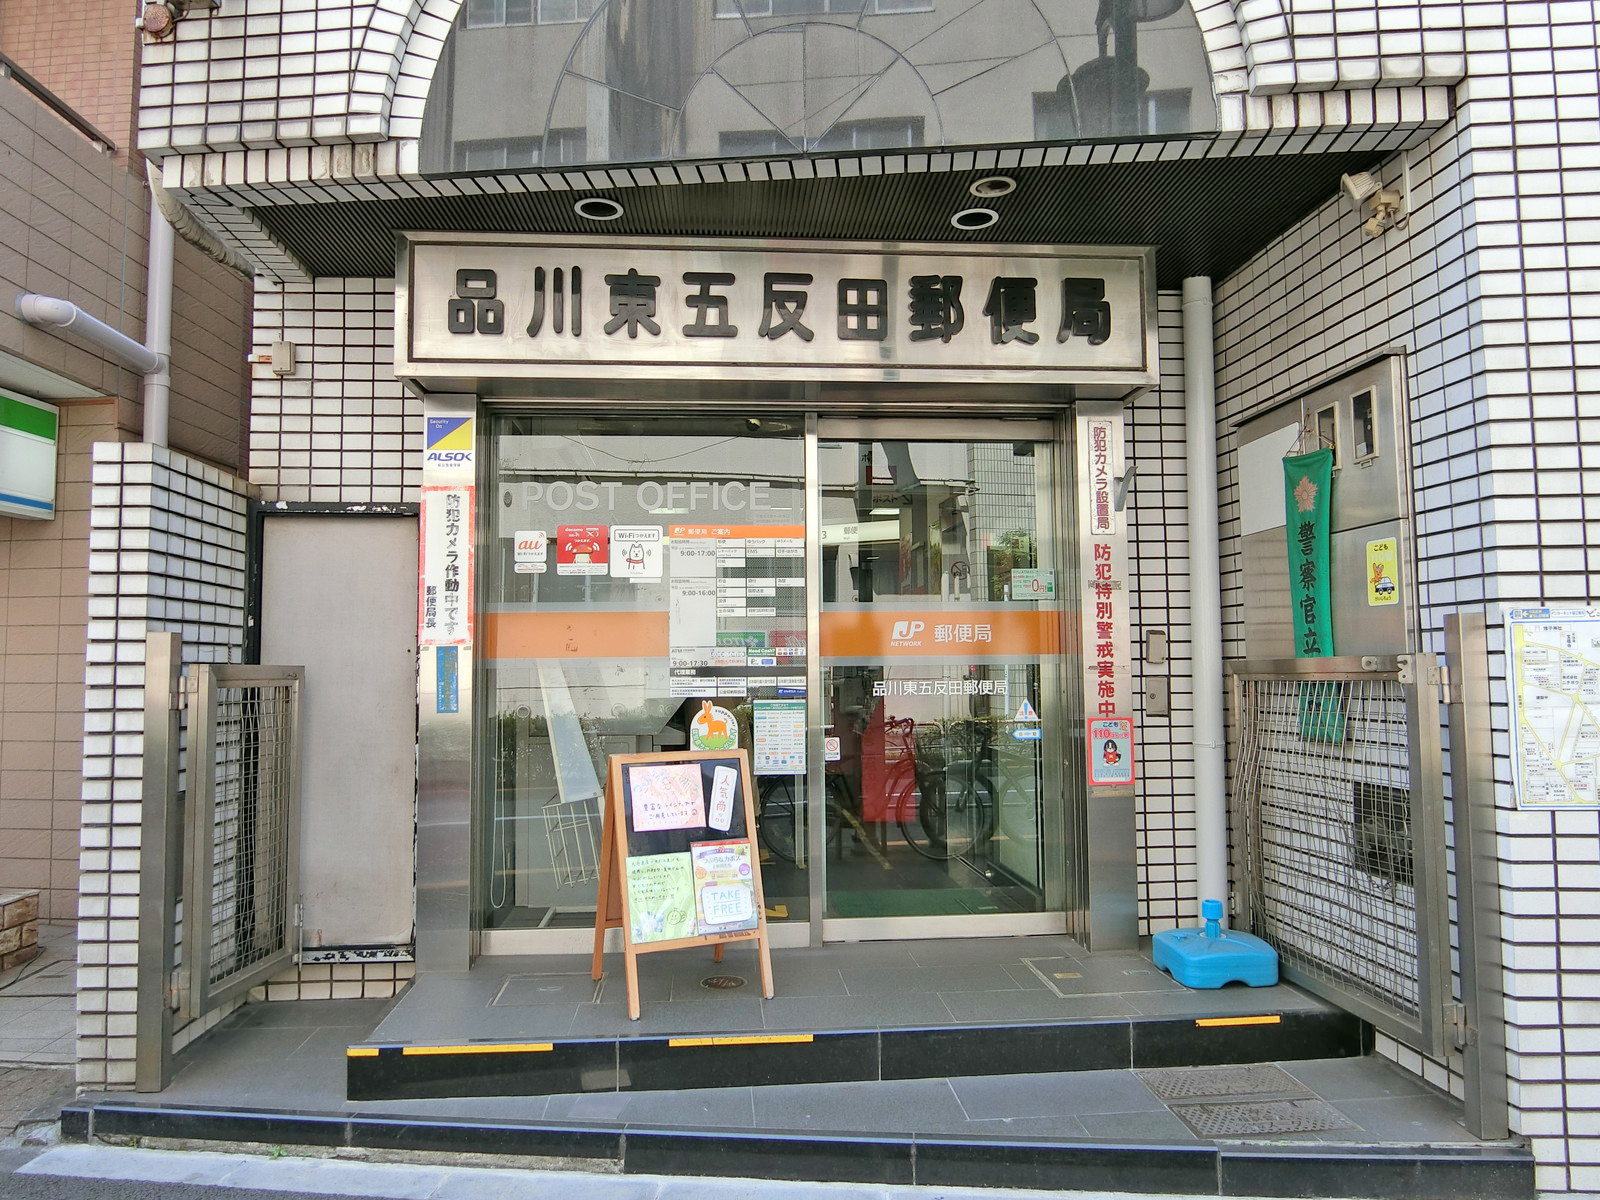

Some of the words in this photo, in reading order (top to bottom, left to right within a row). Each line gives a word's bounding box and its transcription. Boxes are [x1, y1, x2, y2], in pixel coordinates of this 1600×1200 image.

[448, 265, 1111, 345] 品川東五反田郵便局
[427, 452, 472, 462] ALSOK
[1093, 426, 1110, 530] 防犯カメラ設置局
[521, 481, 622, 511] POST
[636, 481, 771, 511] OFFICE
[822, 530, 827, 540] 3
[518, 540, 543, 551] au
[1373, 544, 1389, 552] こども
[444, 493, 460, 635] 防犯カメラ作動中です
[425, 585, 437, 628] 郵便局長
[1297, 520, 1324, 712] 警察官立
[891, 621, 925, 640] JP
[934, 624, 992, 643] 郵便局
[1094, 543, 1116, 718] 防犯特別警戒実施中
[872, 680, 1008, 697] 品川東五反田郵便局
[715, 709, 736, 727] supporter
[711, 890, 741, 900] TAKE
[713, 902, 742, 915] FREE
